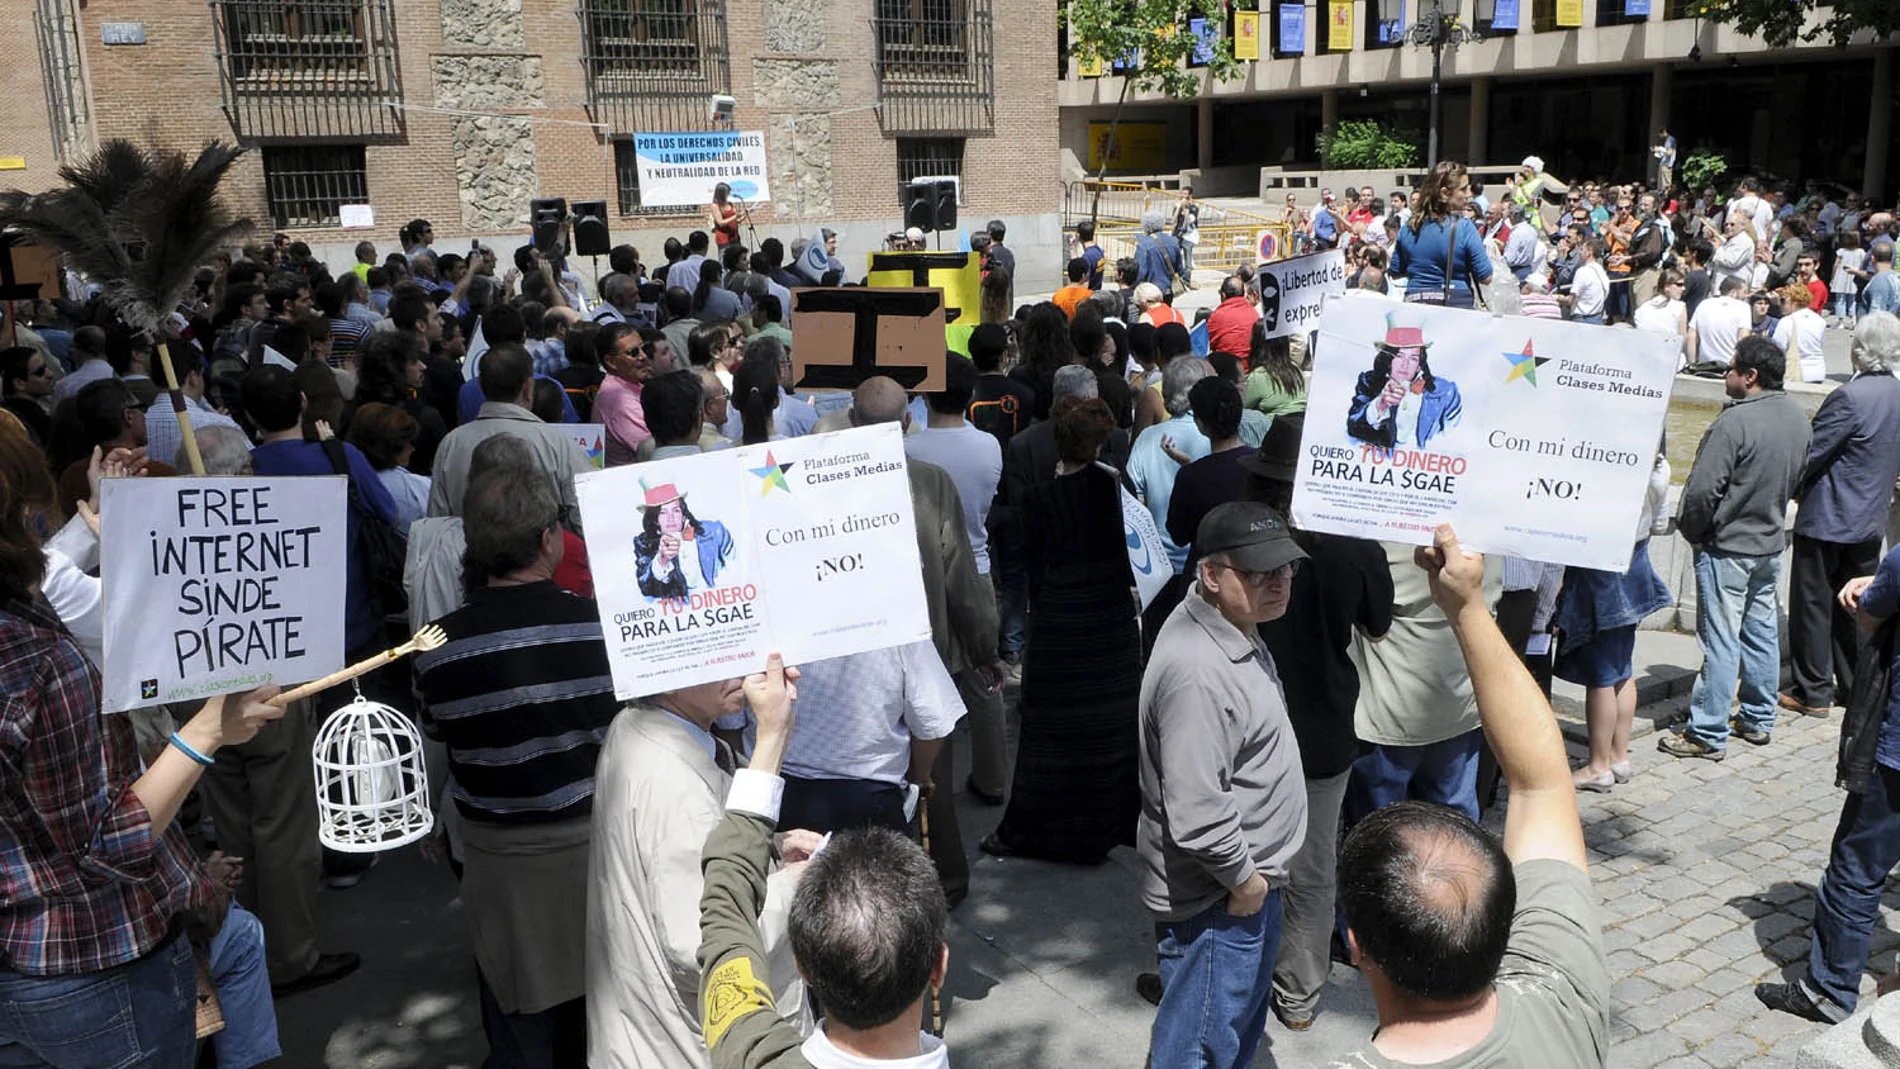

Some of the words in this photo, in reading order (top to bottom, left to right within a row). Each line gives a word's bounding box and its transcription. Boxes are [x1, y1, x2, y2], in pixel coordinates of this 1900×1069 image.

[638, 139, 656, 149] POR
[659, 138, 675, 149] LOS
[678, 138, 724, 148] DERECHOS
[660, 153, 670, 163] LA
[673, 152, 743, 163] UNIVERSALIDAD
[647, 169, 652, 178] Y
[655, 167, 715, 178] NEUTRALIDAD
[718, 166, 728, 177] DE
[731, 166, 740, 176] LA
[743, 166, 760, 176] RED
[1282, 262, 1328, 297] ¡Libertad
[1331, 261, 1342, 280] de
[1559, 359, 1632, 380] Plataforma
[1557, 375, 1605, 392] Clases
[1608, 382, 1663, 399] Medias
[803, 451, 870, 471] Plataforma
[1310, 445, 1354, 461] QUIERO
[1360, 445, 1386, 465] TU
[1392, 450, 1467, 476] DINERO
[1488, 430, 1530, 452] Con
[1537, 438, 1566, 456] mi
[1572, 441, 1638, 467] dinero
[806, 468, 851, 485] Clases
[854, 461, 903, 477] Medias
[1312, 459, 1363, 482] PARA
[1369, 466, 1394, 487] LA
[1401, 469, 1456, 494] $GAE
[1526, 477, 1582, 500] ¡NO!
[178, 486, 279, 528] FREE
[766, 528, 806, 547] Con
[812, 518, 836, 539] mi
[841, 511, 900, 533] dinero
[816, 553, 864, 582] ¡NO!
[614, 607, 655, 625] QUIERO
[658, 595, 684, 616] TU
[690, 583, 757, 611] DINERO
[621, 619, 671, 642] PARA
[675, 613, 700, 632] LA
[704, 603, 755, 627] $GAE
